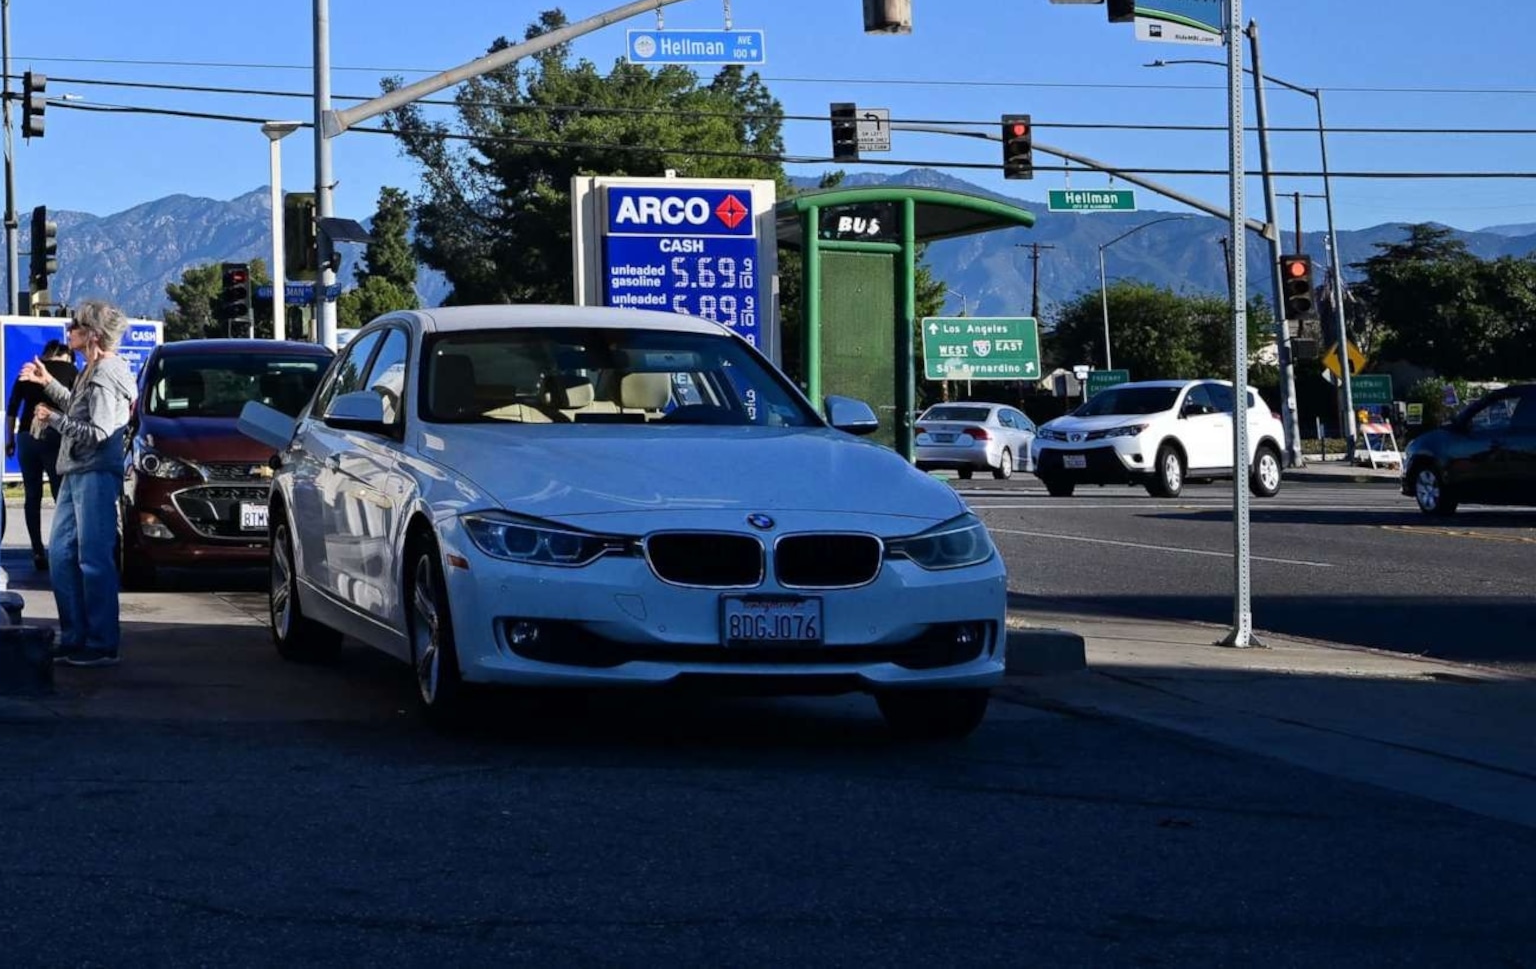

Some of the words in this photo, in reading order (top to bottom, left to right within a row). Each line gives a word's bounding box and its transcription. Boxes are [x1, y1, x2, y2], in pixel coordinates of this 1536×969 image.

[660, 38, 725, 55] Hellman
[737, 36, 752, 45] AVE
[733, 49, 748, 58] 100
[750, 49, 757, 58] W
[1065, 192, 1118, 204] Hellman
[616, 196, 710, 225] ARCO
[838, 216, 881, 235] BUS
[659, 239, 704, 253] CASH
[611, 264, 666, 276] unleaded
[671, 256, 736, 289] 5.69
[611, 276, 661, 288] gasoline
[612, 293, 666, 305] unleaded
[943, 325, 960, 333] Los
[967, 324, 1008, 335] Angeles
[131, 331, 156, 341] CASH
[939, 346, 968, 354] WEST
[995, 342, 1023, 351] EAST
[936, 364, 954, 373] San
[962, 364, 1020, 373] Bernardino
[730, 614, 816, 638] 8DGJ076
